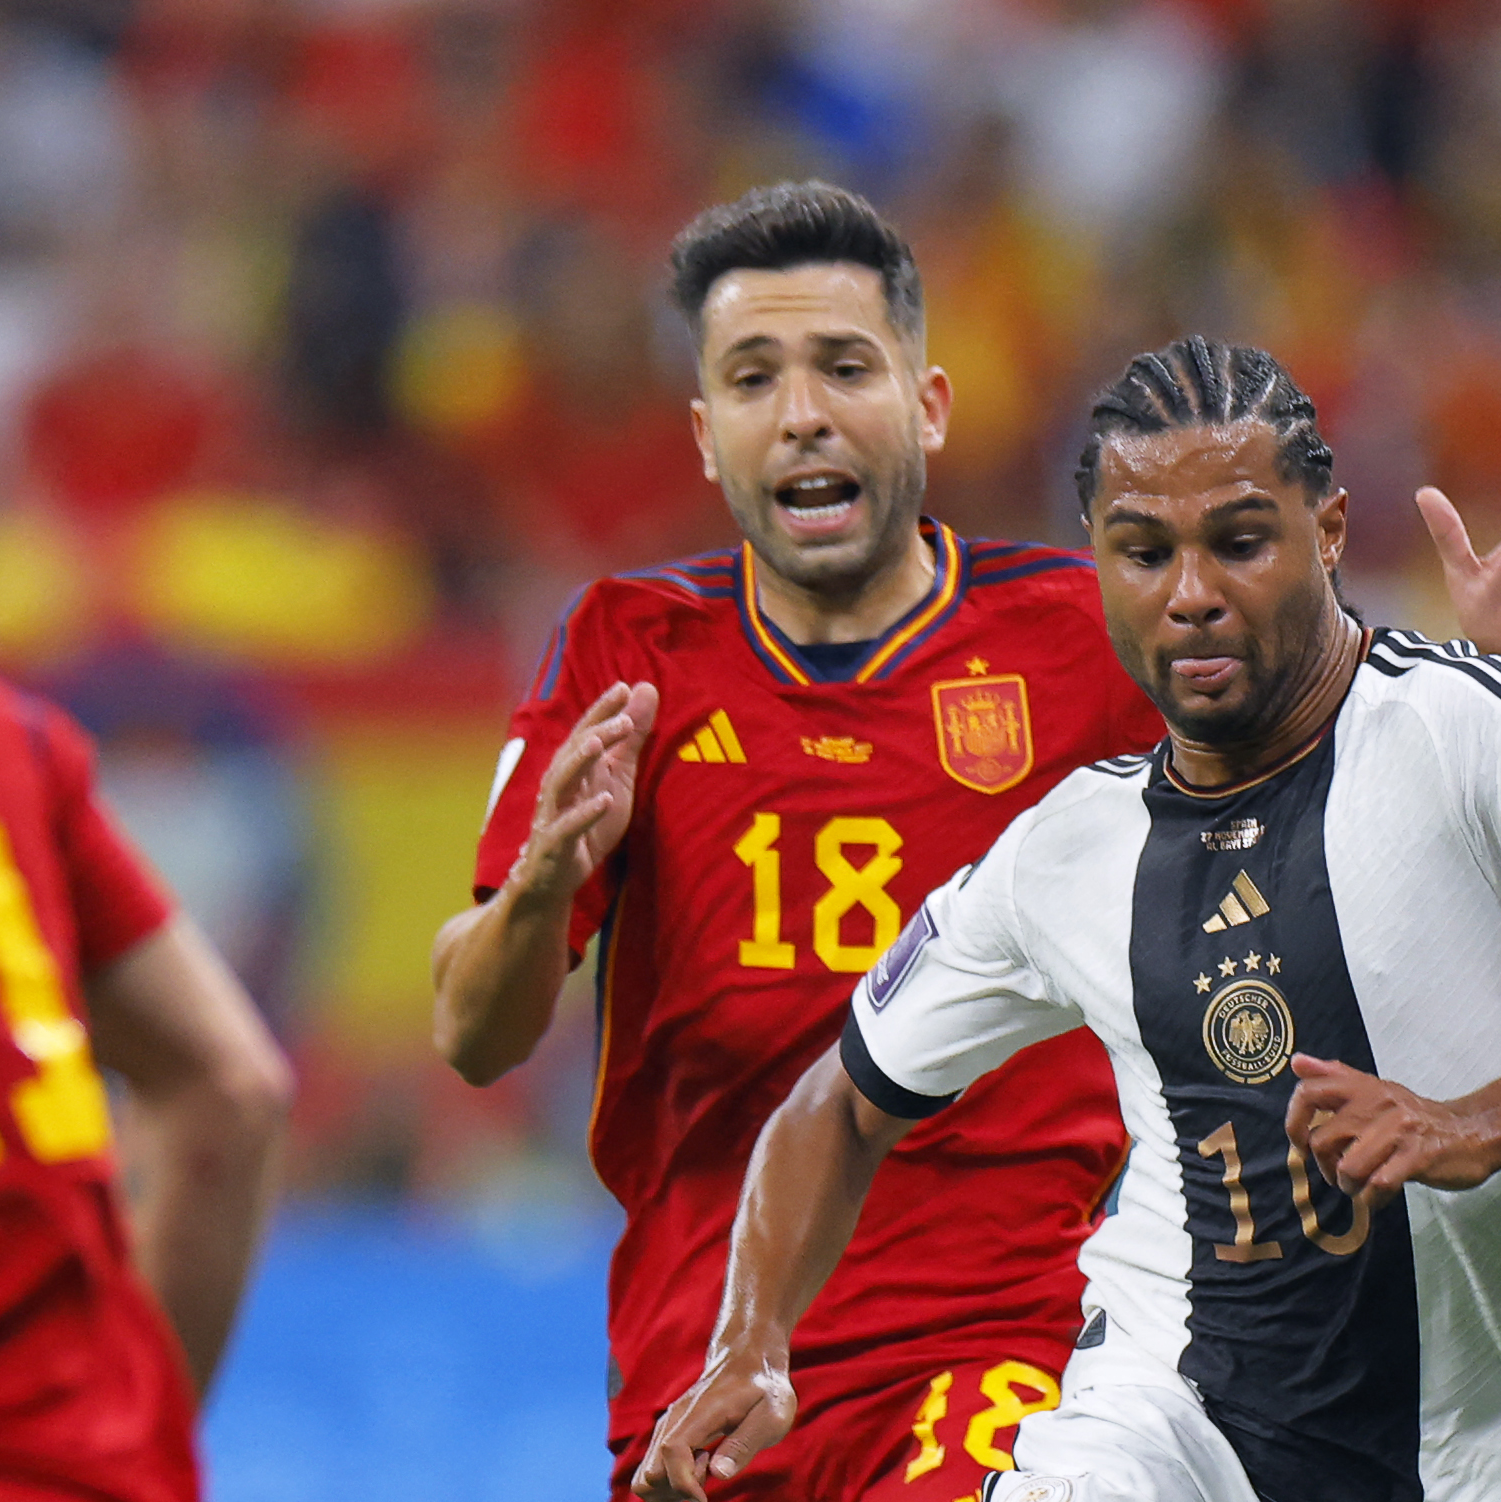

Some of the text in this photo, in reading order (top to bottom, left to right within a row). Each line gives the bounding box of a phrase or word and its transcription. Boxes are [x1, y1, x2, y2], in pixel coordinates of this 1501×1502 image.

[734, 813, 903, 972] 18
[1218, 993, 1269, 1019] DEUTSCHER
[1197, 1109, 1371, 1264] 10
[903, 1359, 1063, 1485] 18
